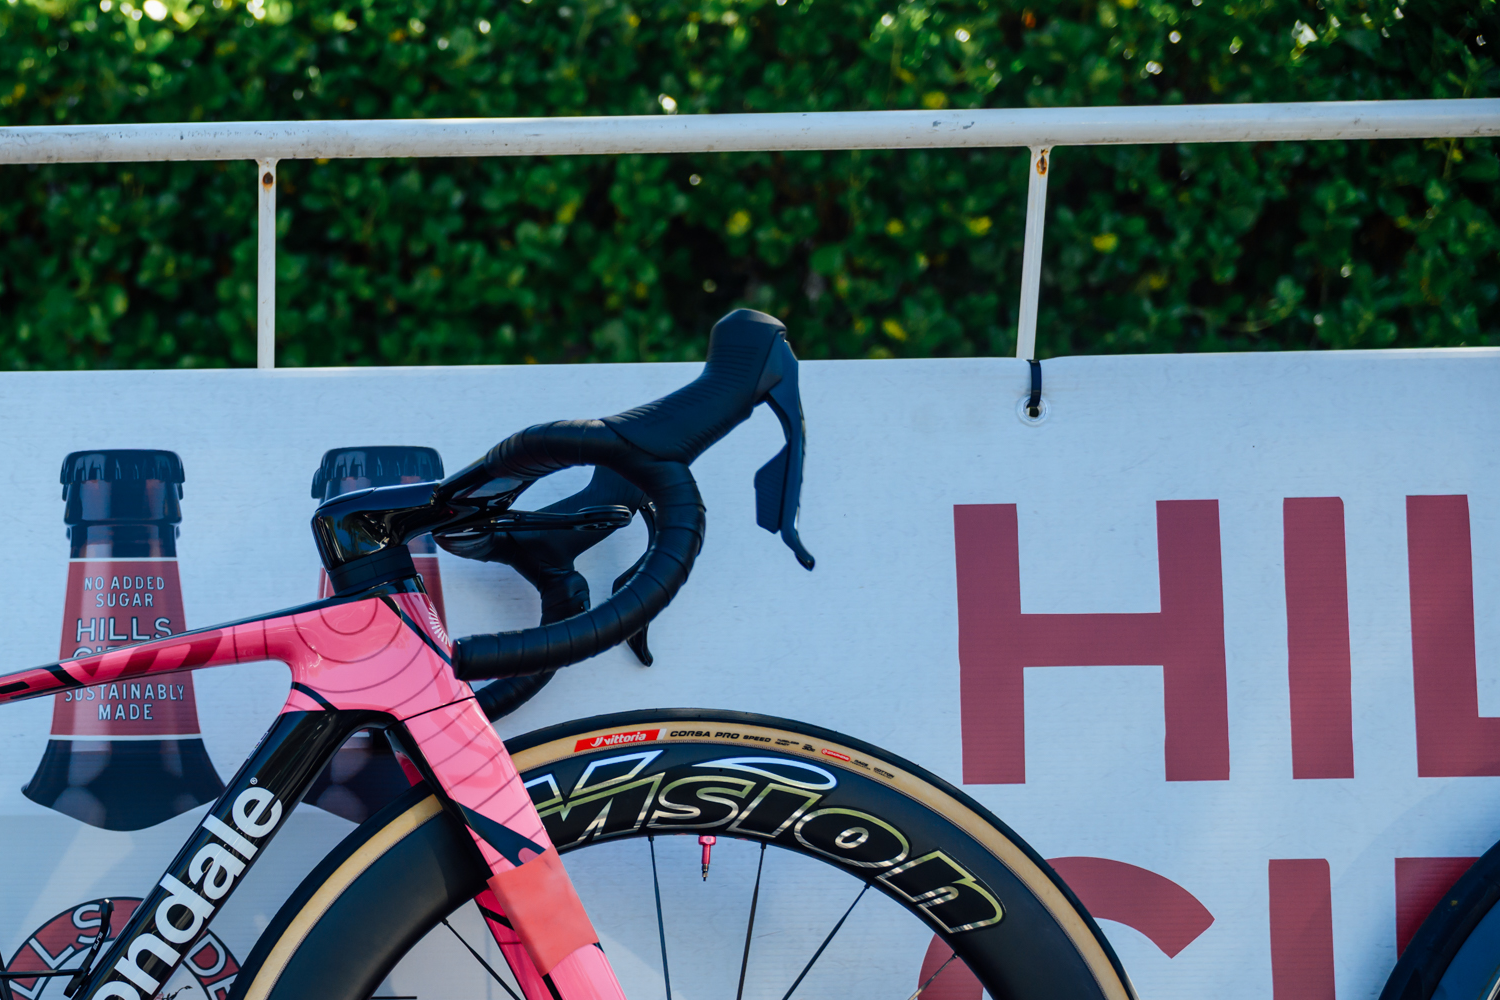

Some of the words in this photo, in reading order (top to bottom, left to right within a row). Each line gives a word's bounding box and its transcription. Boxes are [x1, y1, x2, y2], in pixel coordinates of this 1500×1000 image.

[84, 576, 105, 591] NO
[111, 576, 165, 591] ADDED
[96, 593, 154, 608] SUGAR
[76, 617, 173, 642] HILLS
[65, 683, 185, 702] SUSTAINABLY
[98, 704, 153, 721] MADE
[604, 731, 647, 746] vittoria
[669, 730, 711, 738] CORSA
[714, 731, 740, 740] PRO
[743, 734, 771, 743] SPEED
